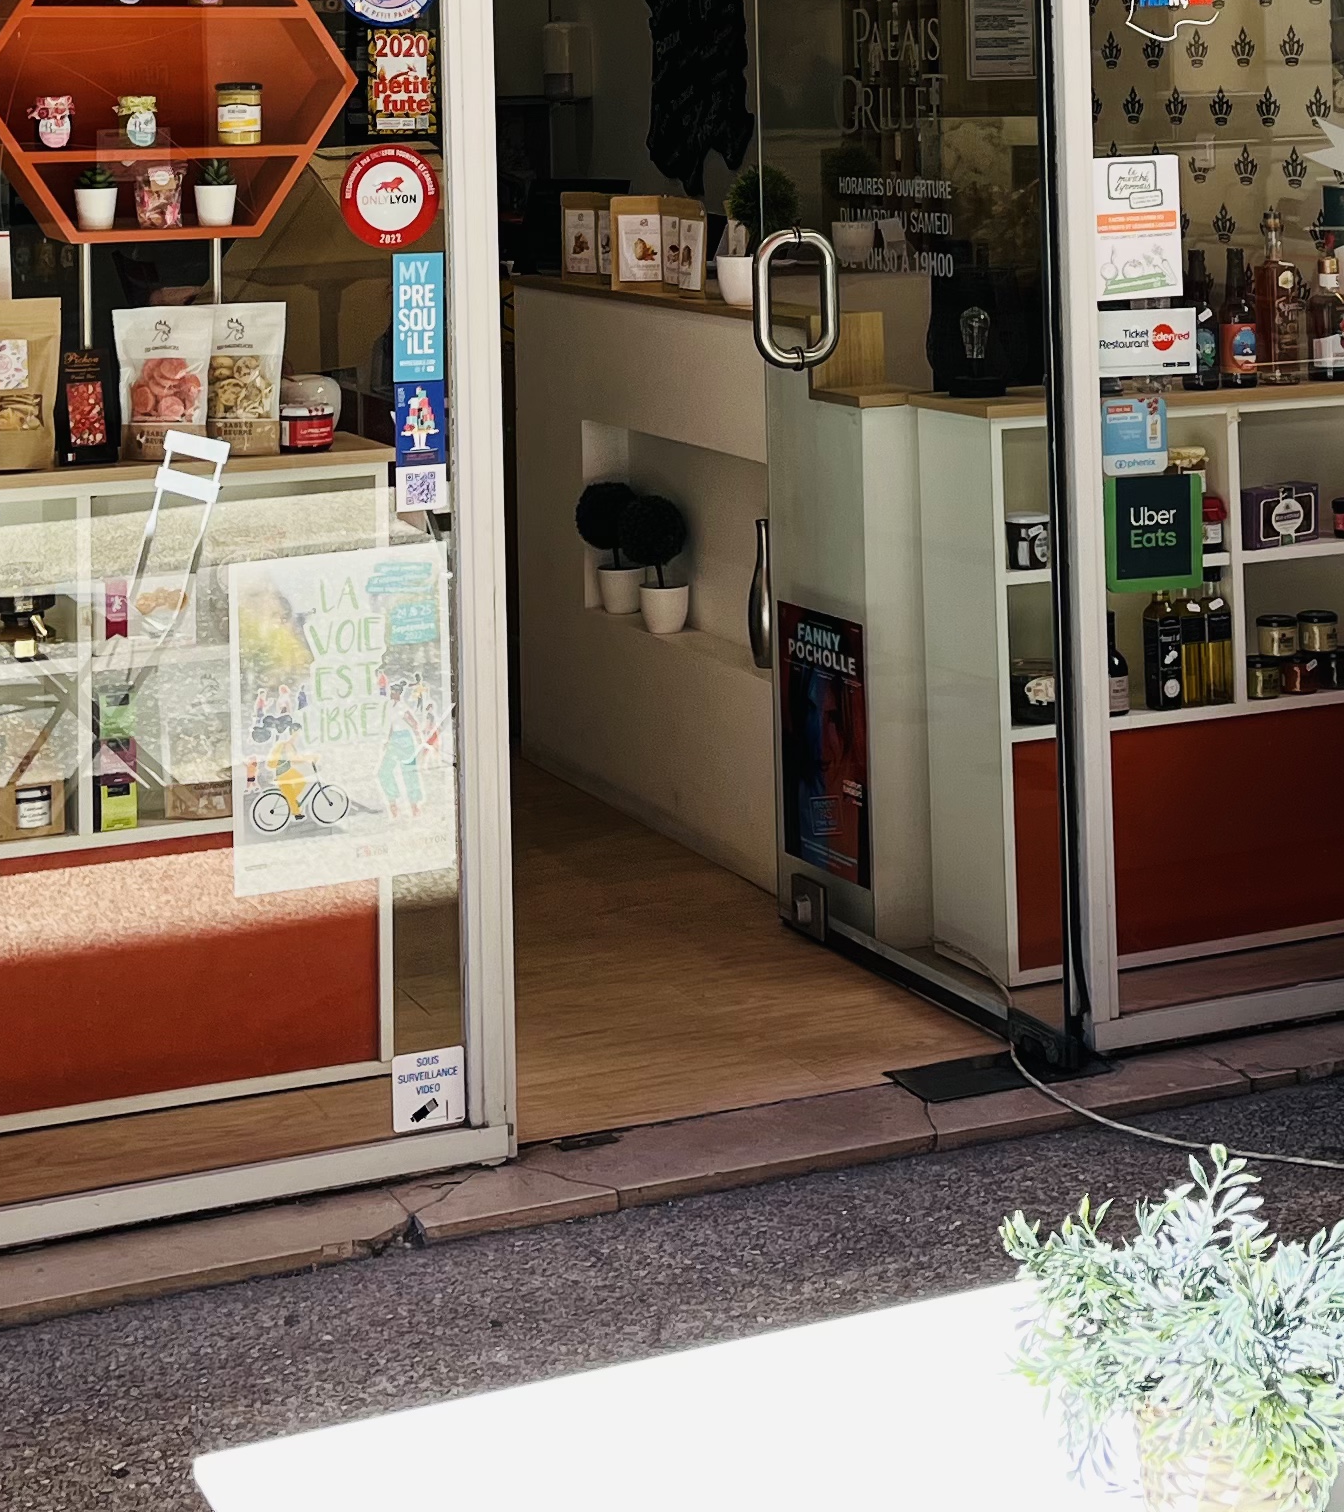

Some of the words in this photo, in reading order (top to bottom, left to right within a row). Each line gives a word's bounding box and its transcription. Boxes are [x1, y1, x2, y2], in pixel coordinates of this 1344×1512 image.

[375, 34, 429, 58] 2020
[853, 8, 941, 68] PALAIS
[373, 74, 430, 100] petit
[834, 73, 948, 136] GRILLET
[839, 176, 884, 196] HORAIRES
[886, 177, 952, 199] D'OUVERTURE
[910, 211, 953, 236] SAMEDI
[379, 233, 403, 245] 2022
[399, 261, 430, 284] MY
[399, 284, 435, 308] PRE
[398, 307, 436, 331] SQU
[1099, 340, 1149, 350] Restaurant
[1122, 329, 1149, 339] Ticket
[1152, 331, 1190, 342] Edenred
[1127, 457, 1156, 469] phenix
[1130, 506, 1177, 527] Uber
[1130, 527, 1177, 550] Eats
[318, 575, 359, 613] LA
[308, 615, 385, 657] VOIE
[797, 622, 841, 653] FANNY
[788, 637, 856, 677] POCHOLLE
[314, 659, 378, 704] EST
[416, 1055, 439, 1068] SOUS
[398, 1065, 459, 1085] SURVEILLANCE
